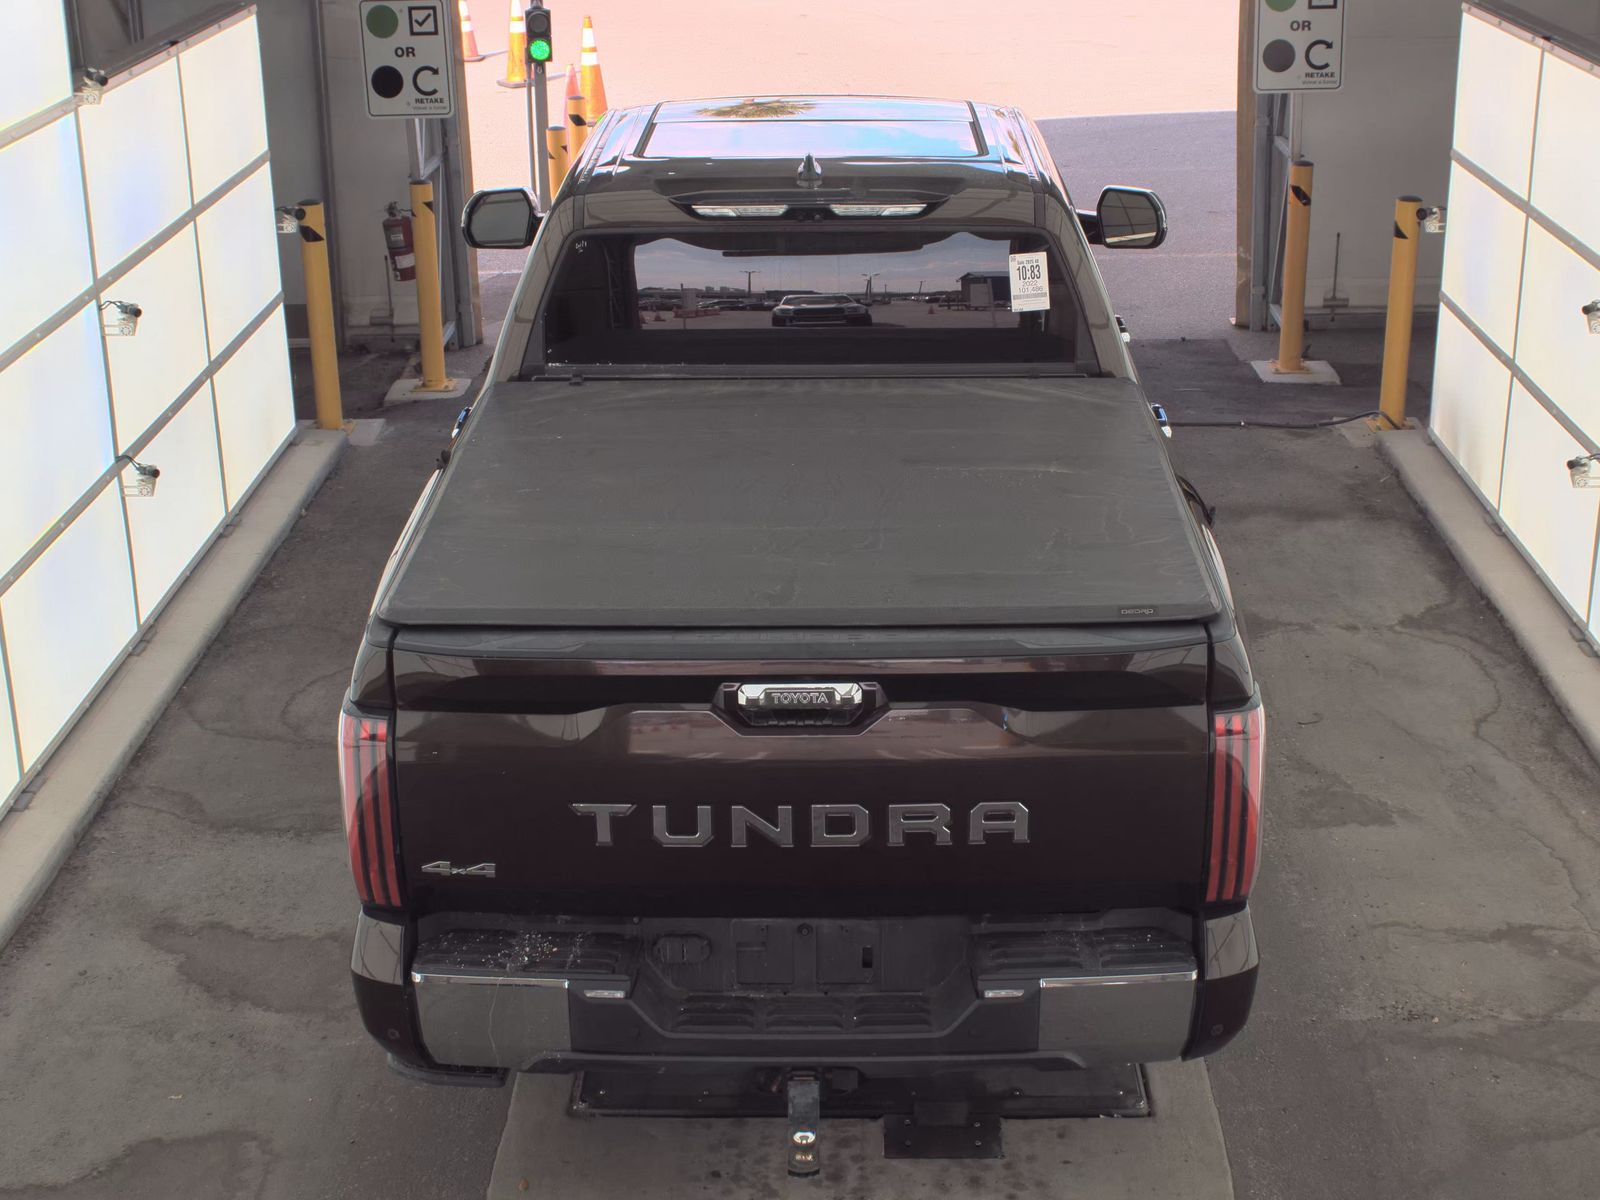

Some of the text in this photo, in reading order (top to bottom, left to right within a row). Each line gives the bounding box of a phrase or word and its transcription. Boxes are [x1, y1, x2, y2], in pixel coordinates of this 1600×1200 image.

[1290, 20, 1311, 31] OR
[394, 46, 416, 58] OR
[1017, 264, 1041, 280] 10:83
[771, 692, 829, 704] TOYOTA
[571, 802, 1030, 847] TUNDRA
